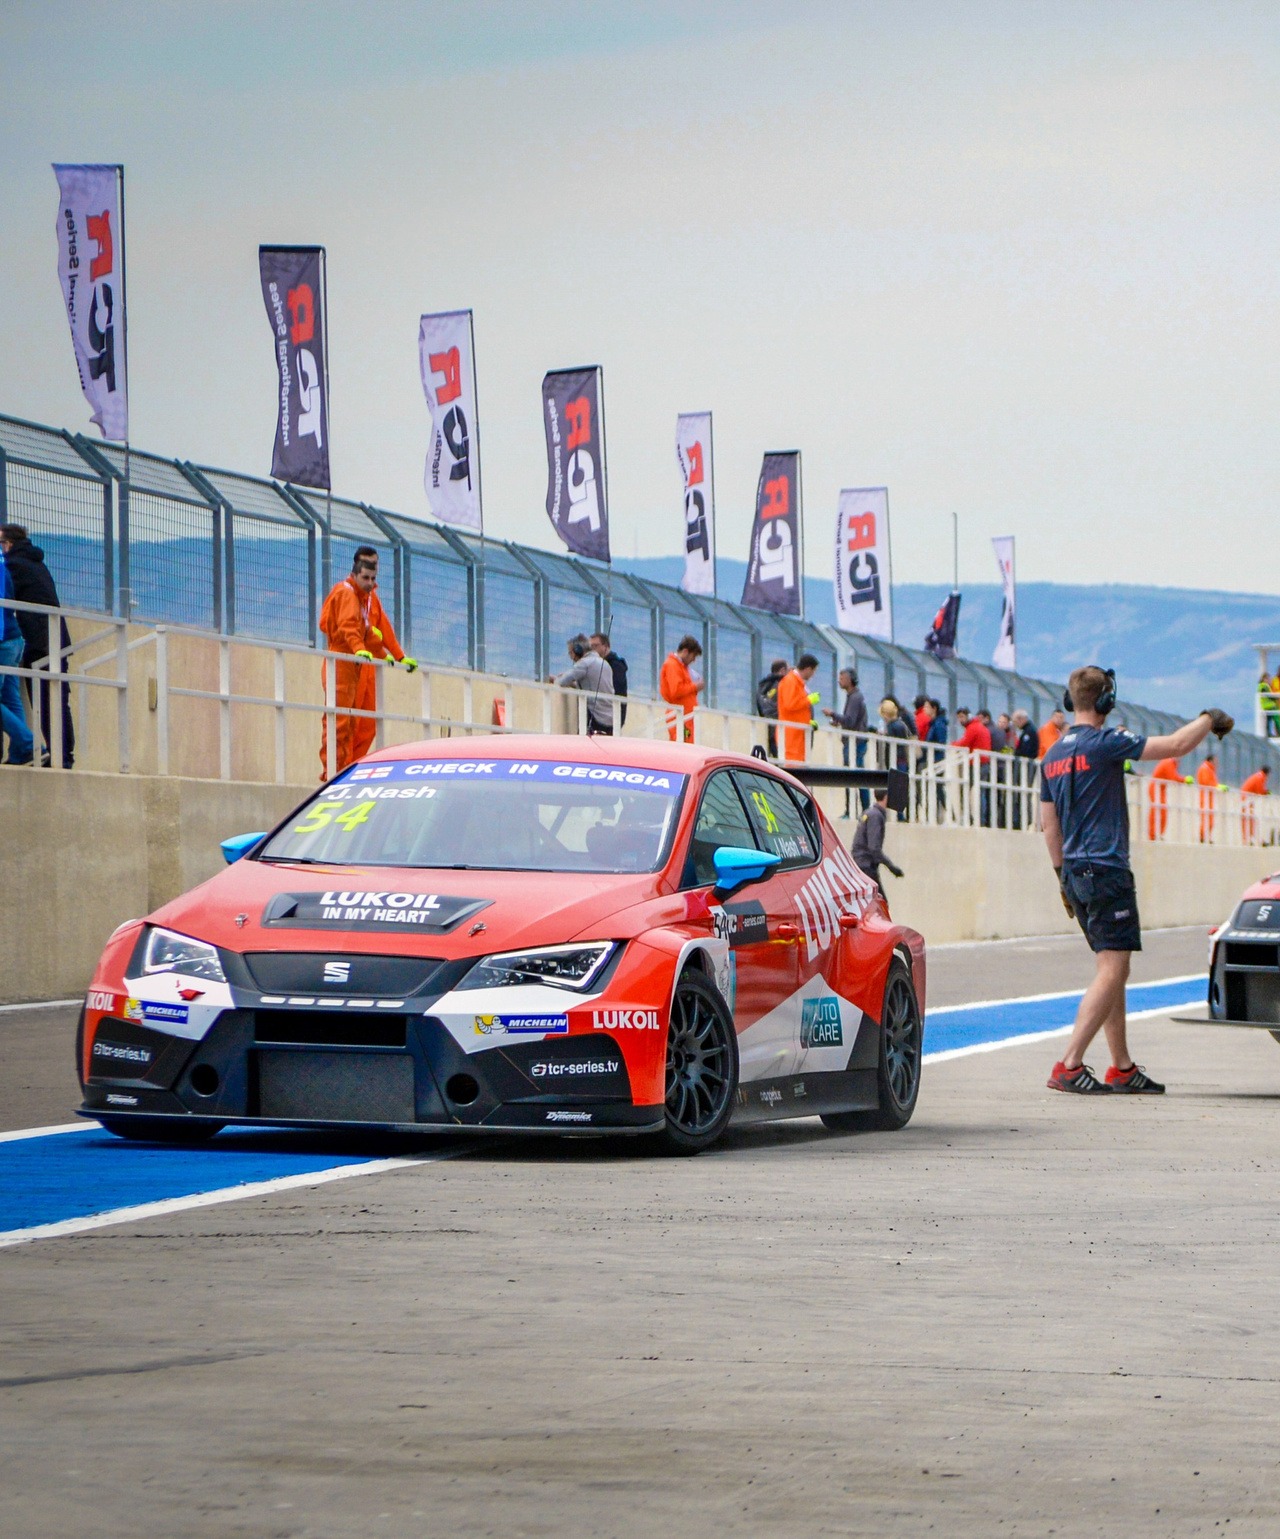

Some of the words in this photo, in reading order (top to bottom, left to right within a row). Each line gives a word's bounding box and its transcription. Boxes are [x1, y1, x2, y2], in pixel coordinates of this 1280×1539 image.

[404, 763, 497, 776] CHECK
[508, 763, 538, 776] IN
[553, 766, 671, 789] GEORGIA
[294, 801, 376, 834] 54
[752, 792, 779, 834] 54
[319, 891, 441, 909] LUKOIL
[794, 846, 874, 963] LUKOIL
[322, 907, 343, 919] IN
[345, 908, 370, 921] MY
[373, 909, 430, 924] HEART
[145, 1006, 188, 1018] MICHELIN
[593, 1011, 659, 1030] LUKOIL
[508, 1018, 566, 1027] MICHELIN
[811, 1023, 840, 1042] CARE
[101, 1044, 151, 1062] tcr-series.tv
[548, 1060, 618, 1076] tcr-series.tv
